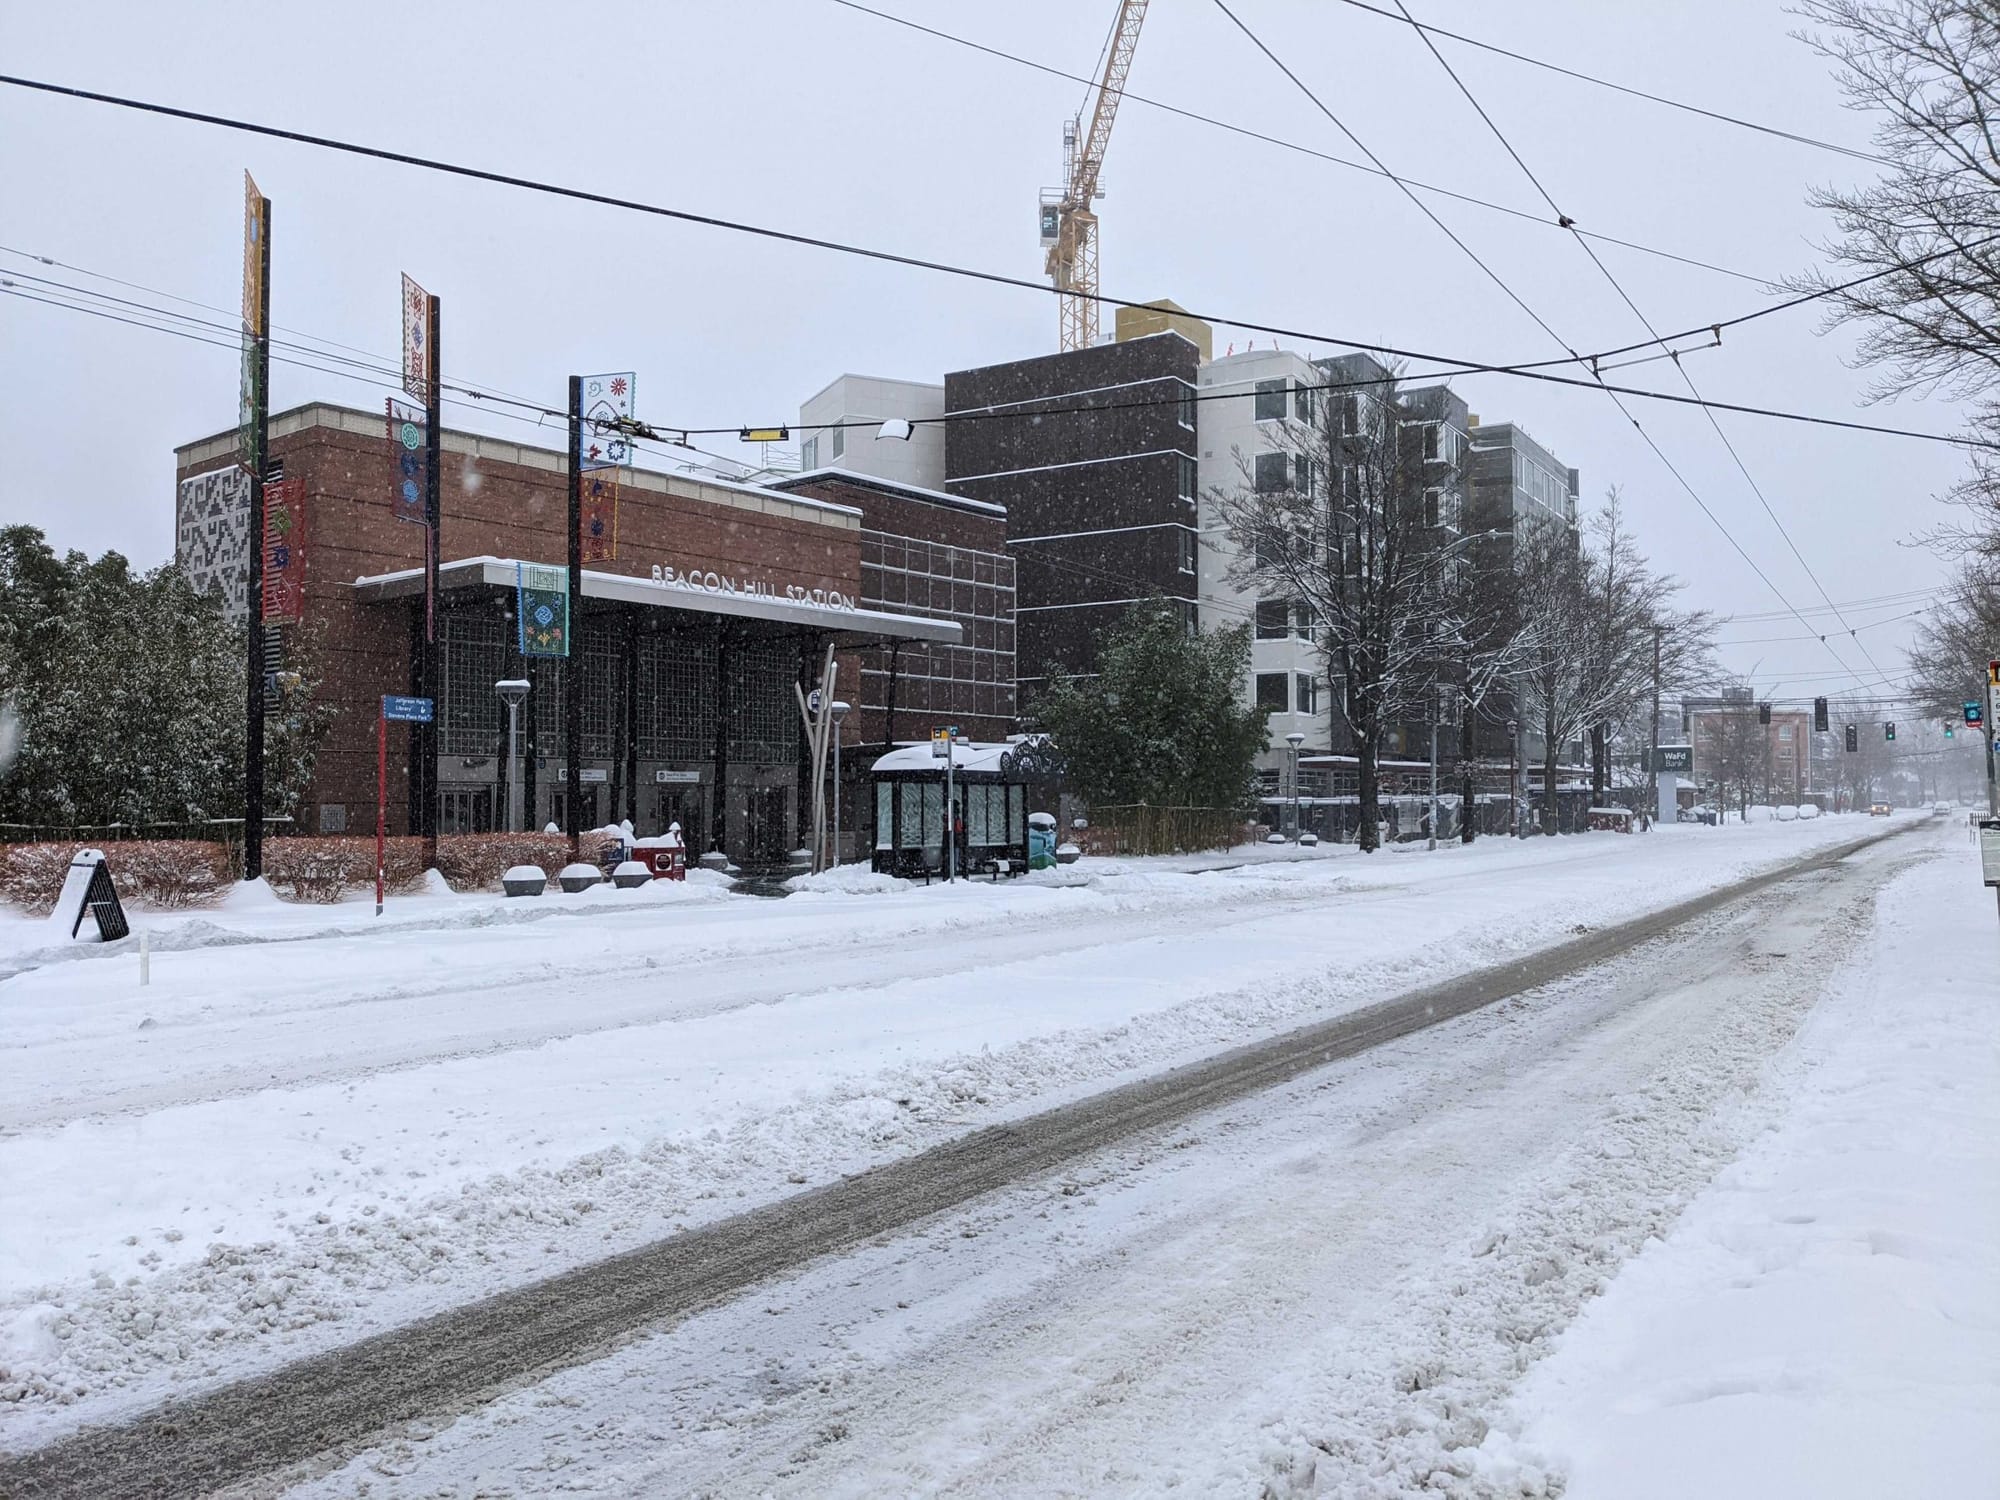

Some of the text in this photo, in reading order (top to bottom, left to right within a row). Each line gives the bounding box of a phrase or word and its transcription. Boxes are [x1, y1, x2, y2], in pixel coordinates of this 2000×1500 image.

[651, 564, 856, 612] BEACON HILL STATION
[1664, 752, 1686, 760] WaFd
